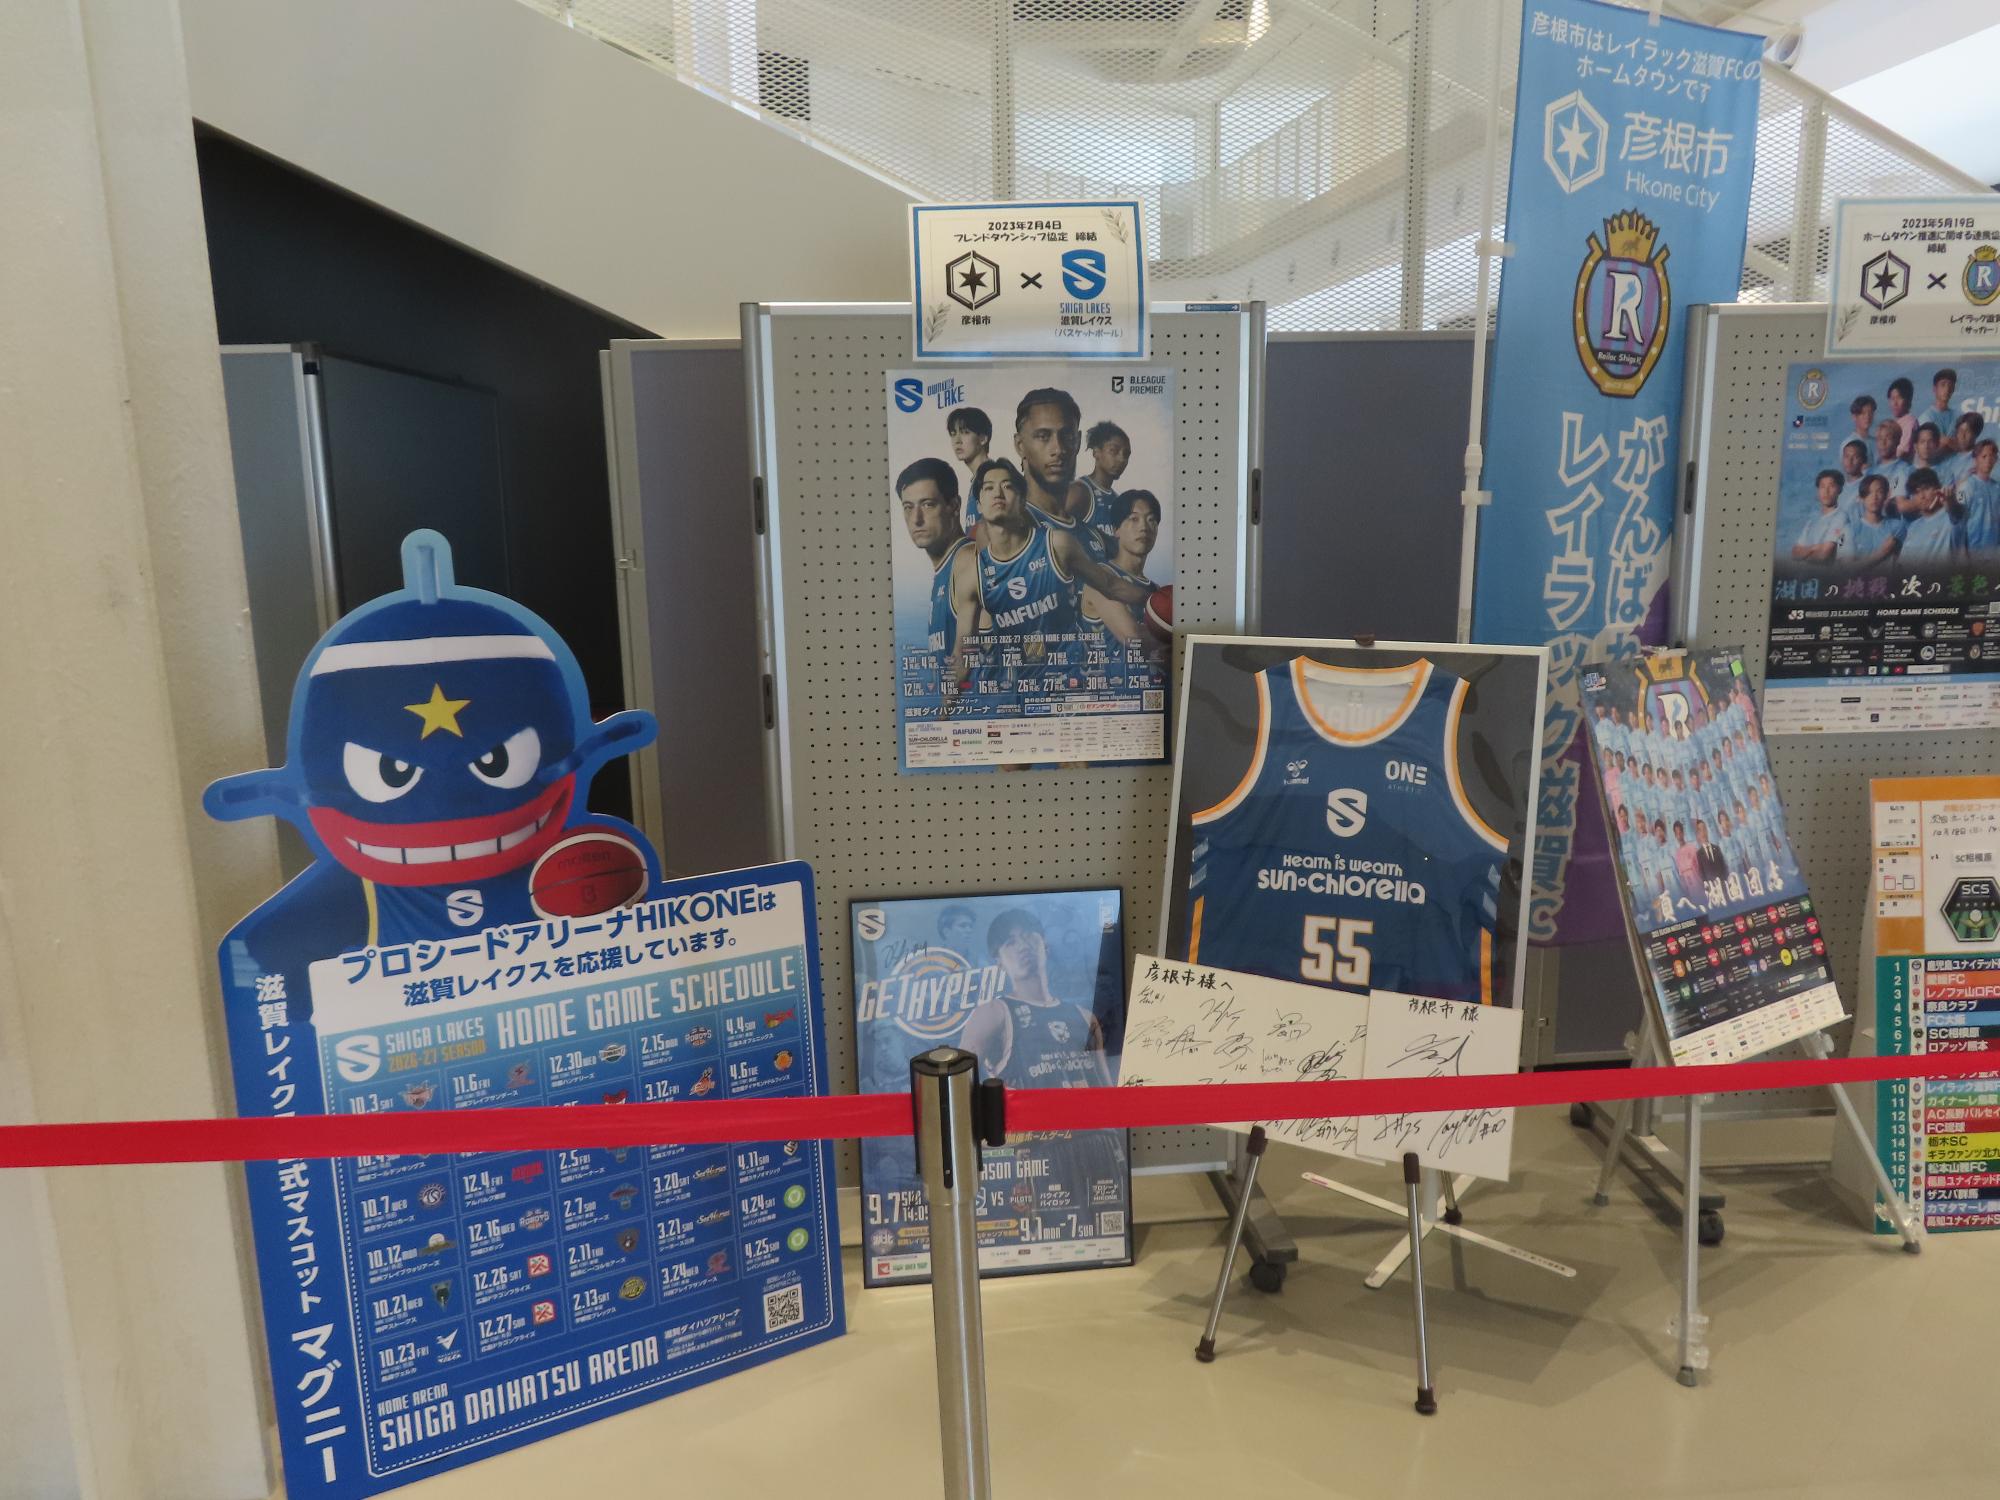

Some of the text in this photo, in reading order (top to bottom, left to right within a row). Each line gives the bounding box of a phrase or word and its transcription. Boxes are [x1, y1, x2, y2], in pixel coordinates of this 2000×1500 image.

[1577, 55, 1712, 103] ホームタウンです
[1619, 111, 1734, 179] 彦根市
[988, 220, 1062, 231] 2023年2月4日
[1902, 217, 1975, 229] 2023年5月19日
[1060, 303, 1111, 314] SHIGA LAKES
[1603, 270, 1644, 344] R
[1130, 385, 1164, 395] PREMIER
[1385, 760, 1428, 785] ONE
[1962, 884, 1990, 895] SCS
[342, 888, 777, 984] プロシードアリーナHIKONEは
[1301, 915, 1374, 986] 55
[402, 929, 737, 1008] 滋賀レイクスを応援しています。
[1145, 961, 1233, 991] 彦根市様へ
[1894, 962, 1900, 972] 1
[1894, 976, 1901, 986] 2
[497, 956, 796, 1049] HOME GAME SCHEDULE
[1894, 989, 1901, 999] 3
[1894, 1002, 1901, 1012] 4
[726, 1016, 744, 1034] 4.4
[1894, 1016, 1901, 1026] 5
[385, 1017, 485, 1054] SHIGA LAKES
[642, 1034, 664, 1054] 2.15
[1894, 1030, 1902, 1040] 6
[1894, 1044, 1902, 1053] 7
[550, 1051, 582, 1073] 12.30
[730, 1062, 748, 1080] 4.6
[453, 1074, 478, 1095] 11.6
[645, 1080, 669, 1101] 3.12
[1892, 1085, 1905, 1094] 10
[349, 1092, 379, 1114] 10.3
[1892, 1098, 1905, 1107] 11
[1892, 1112, 1905, 1121] 12
[1892, 1125, 1905, 1134] 13
[255, 974, 322, 1314] 滋賀レイク式マスコット
[1892, 1136, 1968, 1148] 14 栃木SC
[559, 1150, 579, 1170] 2.5
[738, 1151, 759, 1170] 4.11
[1892, 1152, 1905, 1161] 15
[982, 1159, 1050, 1181] ASON GAME
[1892, 1165, 1905, 1174] 16
[463, 1170, 490, 1193] 12.4
[653, 1172, 679, 1194] 3.20
[1892, 1178, 1905, 1188] 17
[361, 1196, 389, 1218] 10.7
[564, 1197, 583, 1218] 2.7
[741, 1195, 764, 1215] 4.24
[868, 1191, 901, 1224] 9.7
[991, 1191, 1004, 1206] VS
[468, 1219, 500, 1243] 12.16
[657, 1219, 681, 1240] 3.21
[1020, 1216, 1042, 1242] 9.1
[1043, 1227, 1060, 1240] MON
[1078, 1225, 1093, 1237] SUN
[367, 1244, 401, 1269] 10.12
[569, 1243, 590, 1264] 2.11
[744, 1238, 769, 1259] 4.25
[473, 1266, 507, 1291] 12.26
[661, 1263, 686, 1284] 3.24
[373, 1294, 407, 1319] 10.21
[573, 1289, 597, 1311] 2.13
[479, 1314, 513, 1339] 12.27
[379, 1342, 416, 1368] 10.23
[291, 1323, 347, 1483] マグニー
[377, 1383, 448, 1417] HOME ARENA
[380, 1400, 456, 1451] SHIGA
[464, 1359, 581, 1426] DAIHATSU
[588, 1336, 659, 1385] ARENA
